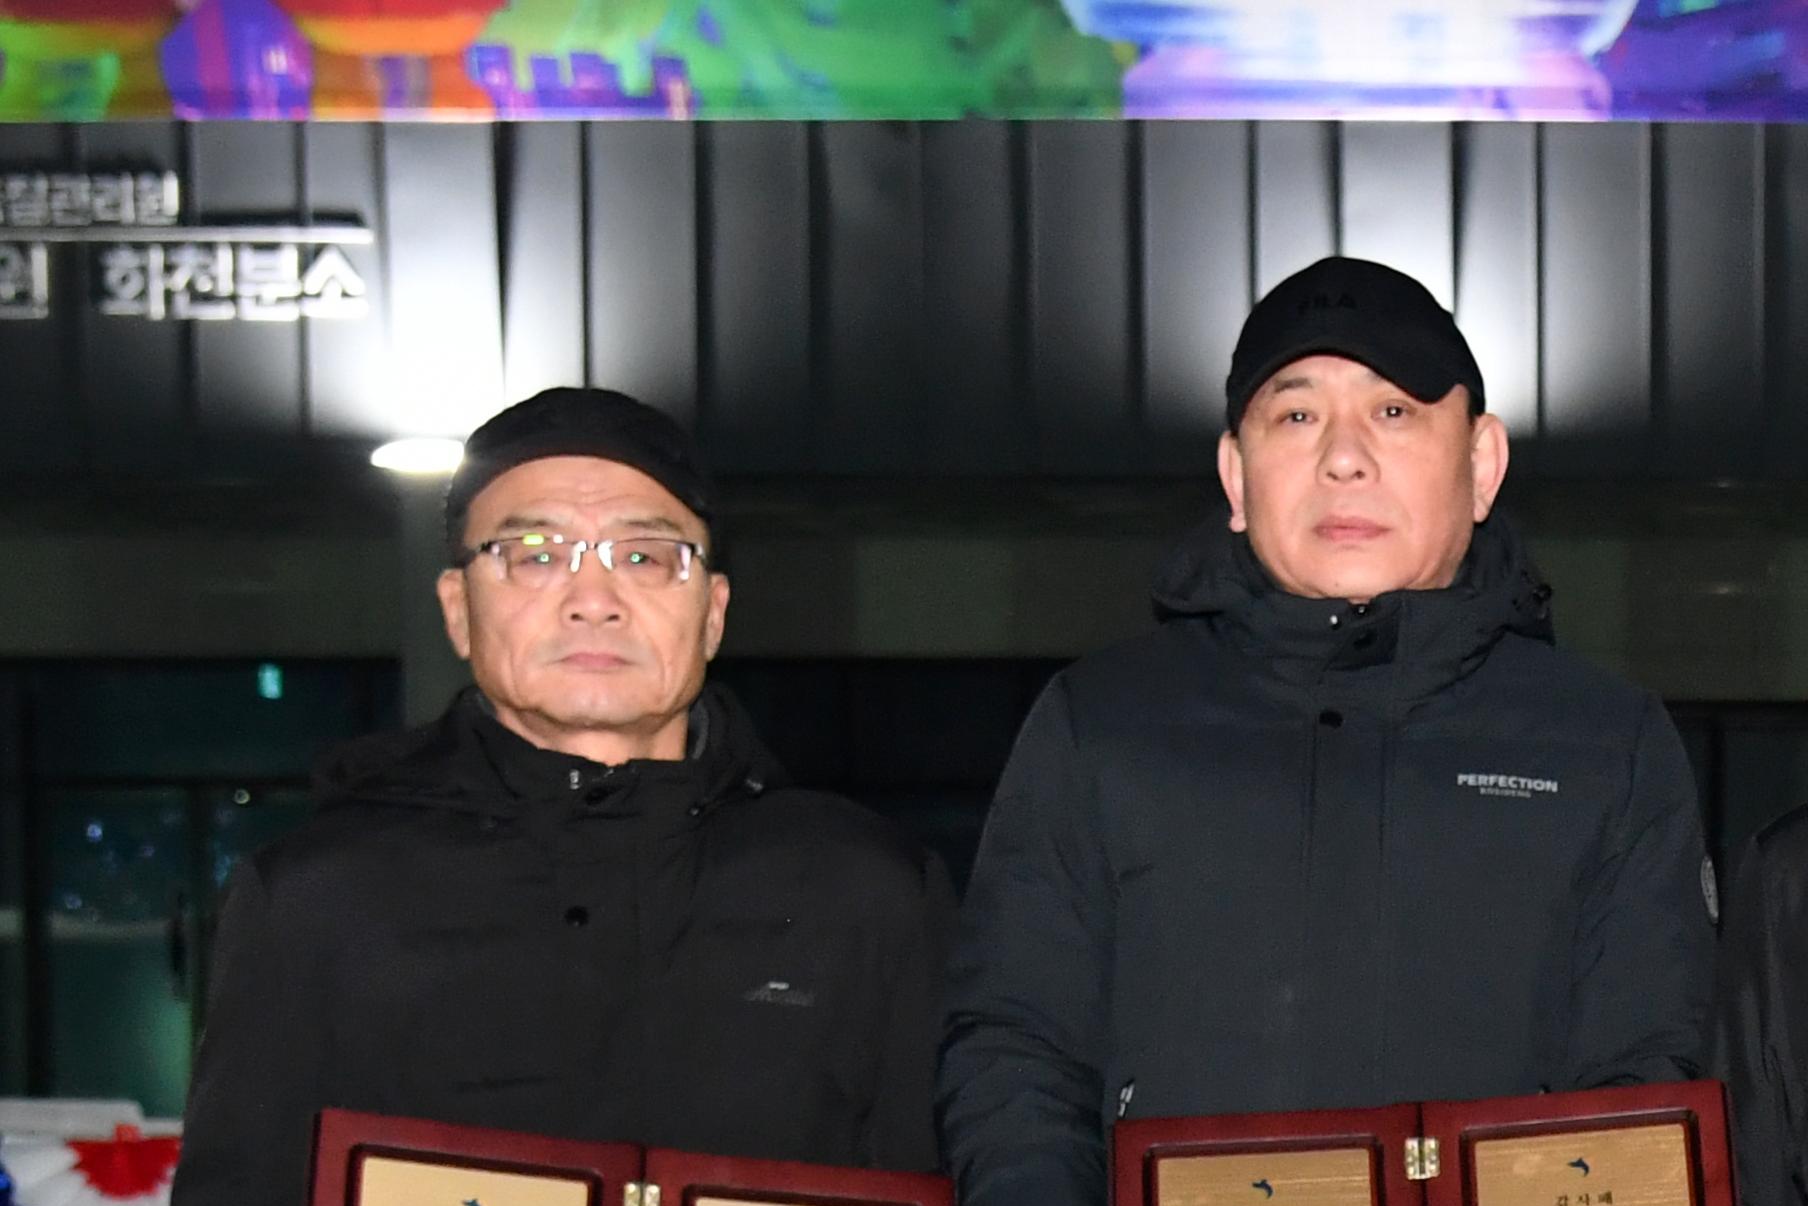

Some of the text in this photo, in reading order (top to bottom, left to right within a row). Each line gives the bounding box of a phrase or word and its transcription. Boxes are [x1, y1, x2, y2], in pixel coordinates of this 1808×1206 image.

[0, 170, 179, 226] 질관리원
[99, 242, 370, 321] 화천분소
[1457, 773, 1558, 793] PERFECTION
